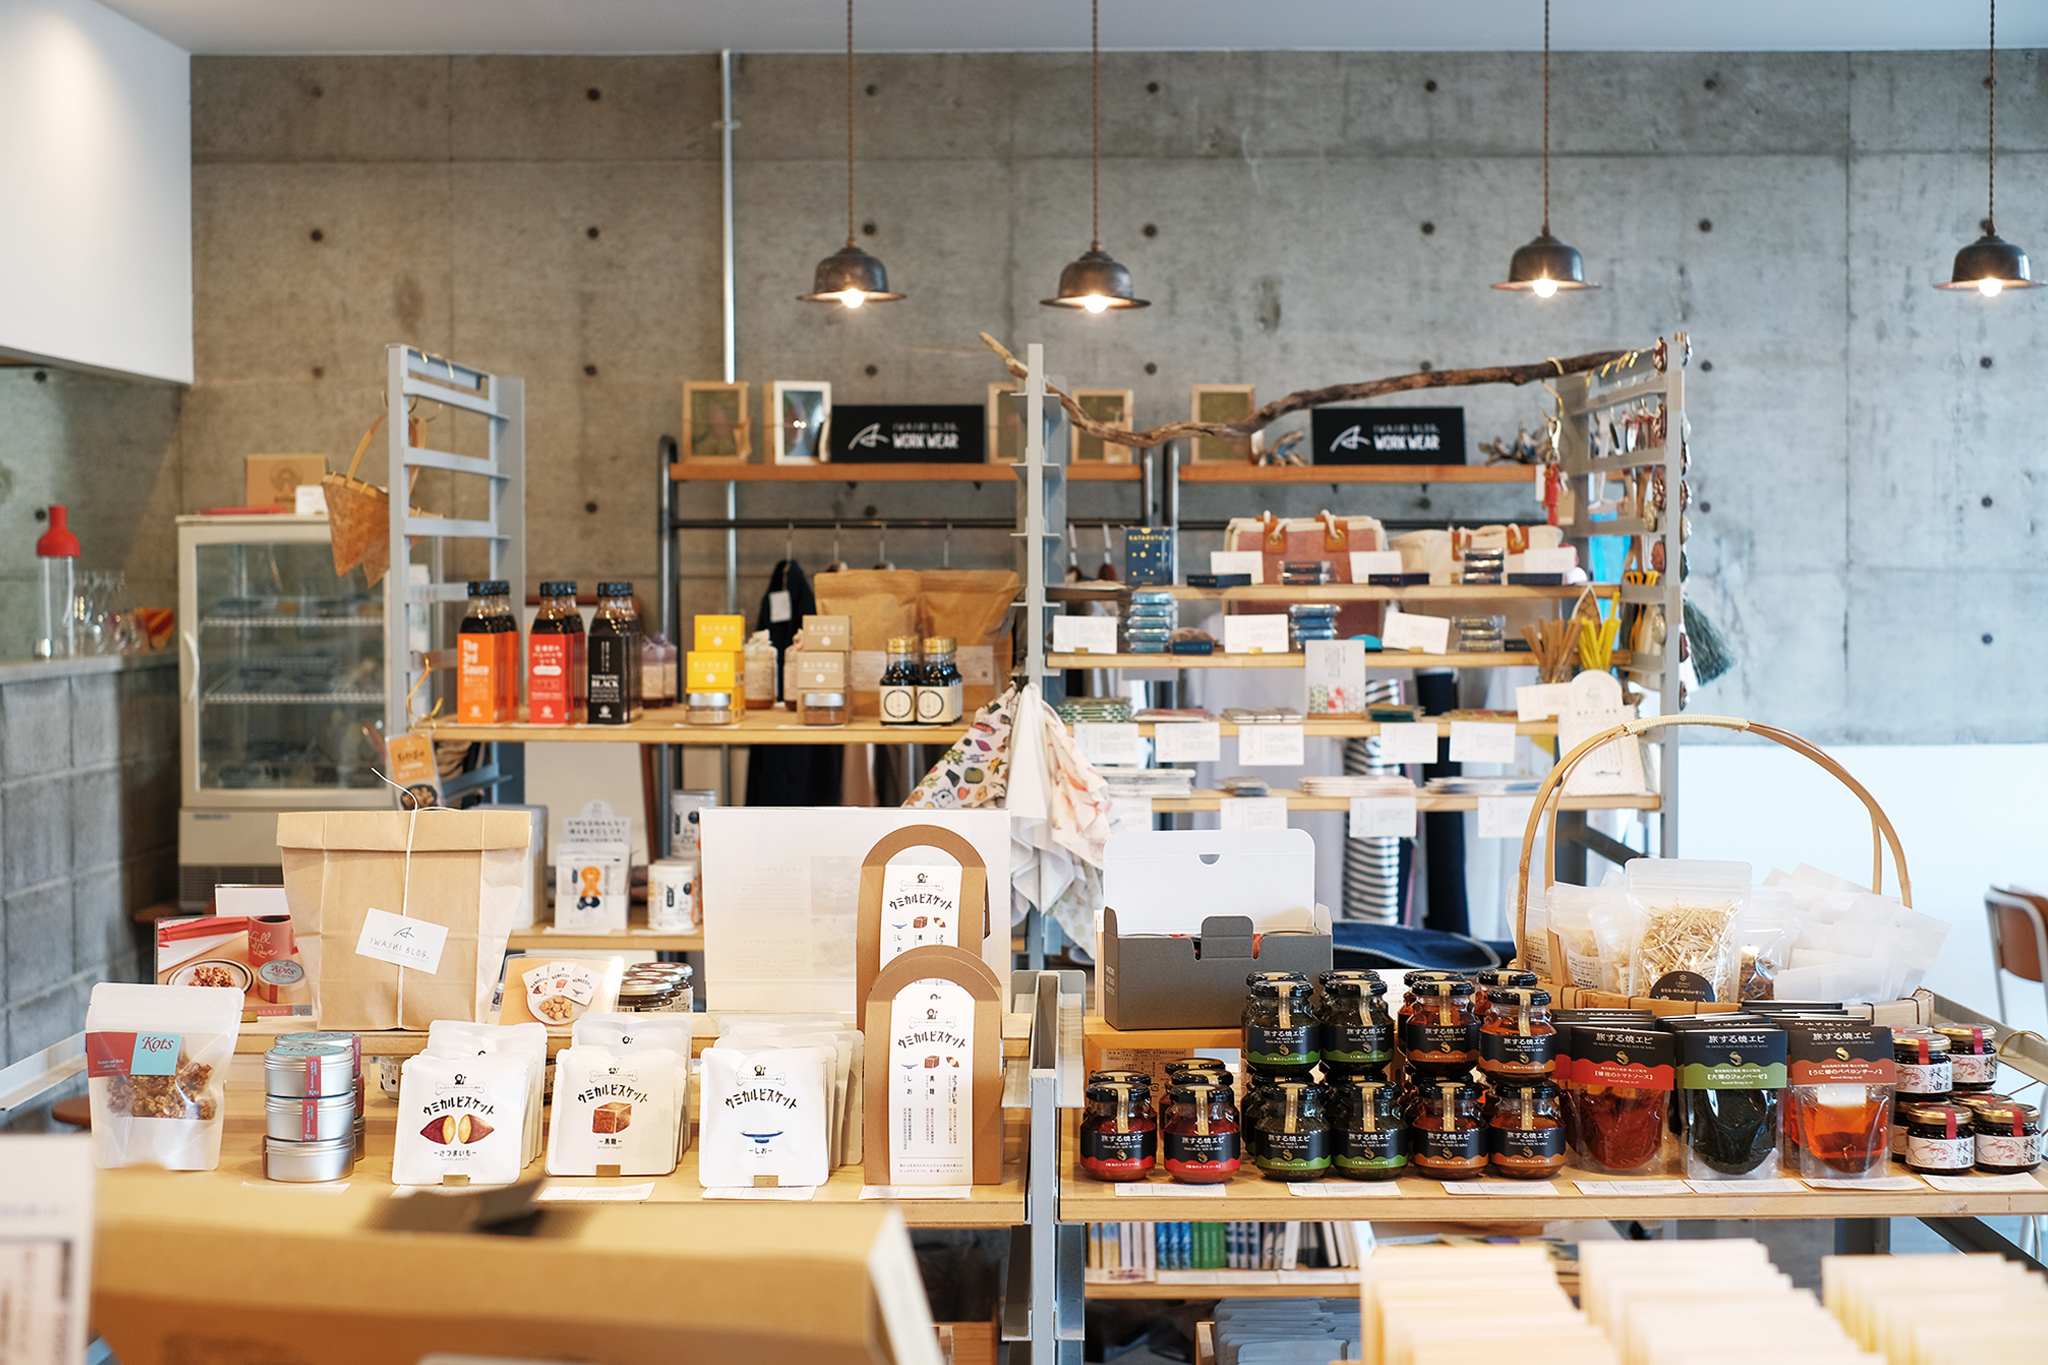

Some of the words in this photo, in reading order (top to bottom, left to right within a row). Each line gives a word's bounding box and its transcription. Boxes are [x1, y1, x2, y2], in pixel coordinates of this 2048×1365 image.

[893, 433, 926, 448] WORK
[927, 433, 959, 448] WEAR
[1374, 435, 1407, 450] WORK
[1408, 435, 1440, 450] WEAR
[463, 639, 479, 651] The
[889, 893, 953, 910] ウミカルビスケット
[271, 964, 297, 975] Kots
[898, 1031, 966, 1049] ウミカルビスケット
[1595, 1032, 1654, 1045] 旅する焼エビ
[1708, 1035, 1767, 1044] 旅する焼エビ
[1812, 1031, 1872, 1041] 旅する焼エビ
[141, 1036, 175, 1053] Kots
[577, 1084, 648, 1103] ウミカルビスケット
[725, 1088, 797, 1109] ウミカルビスケット
[423, 1096, 494, 1116] ウミカルビスケット
